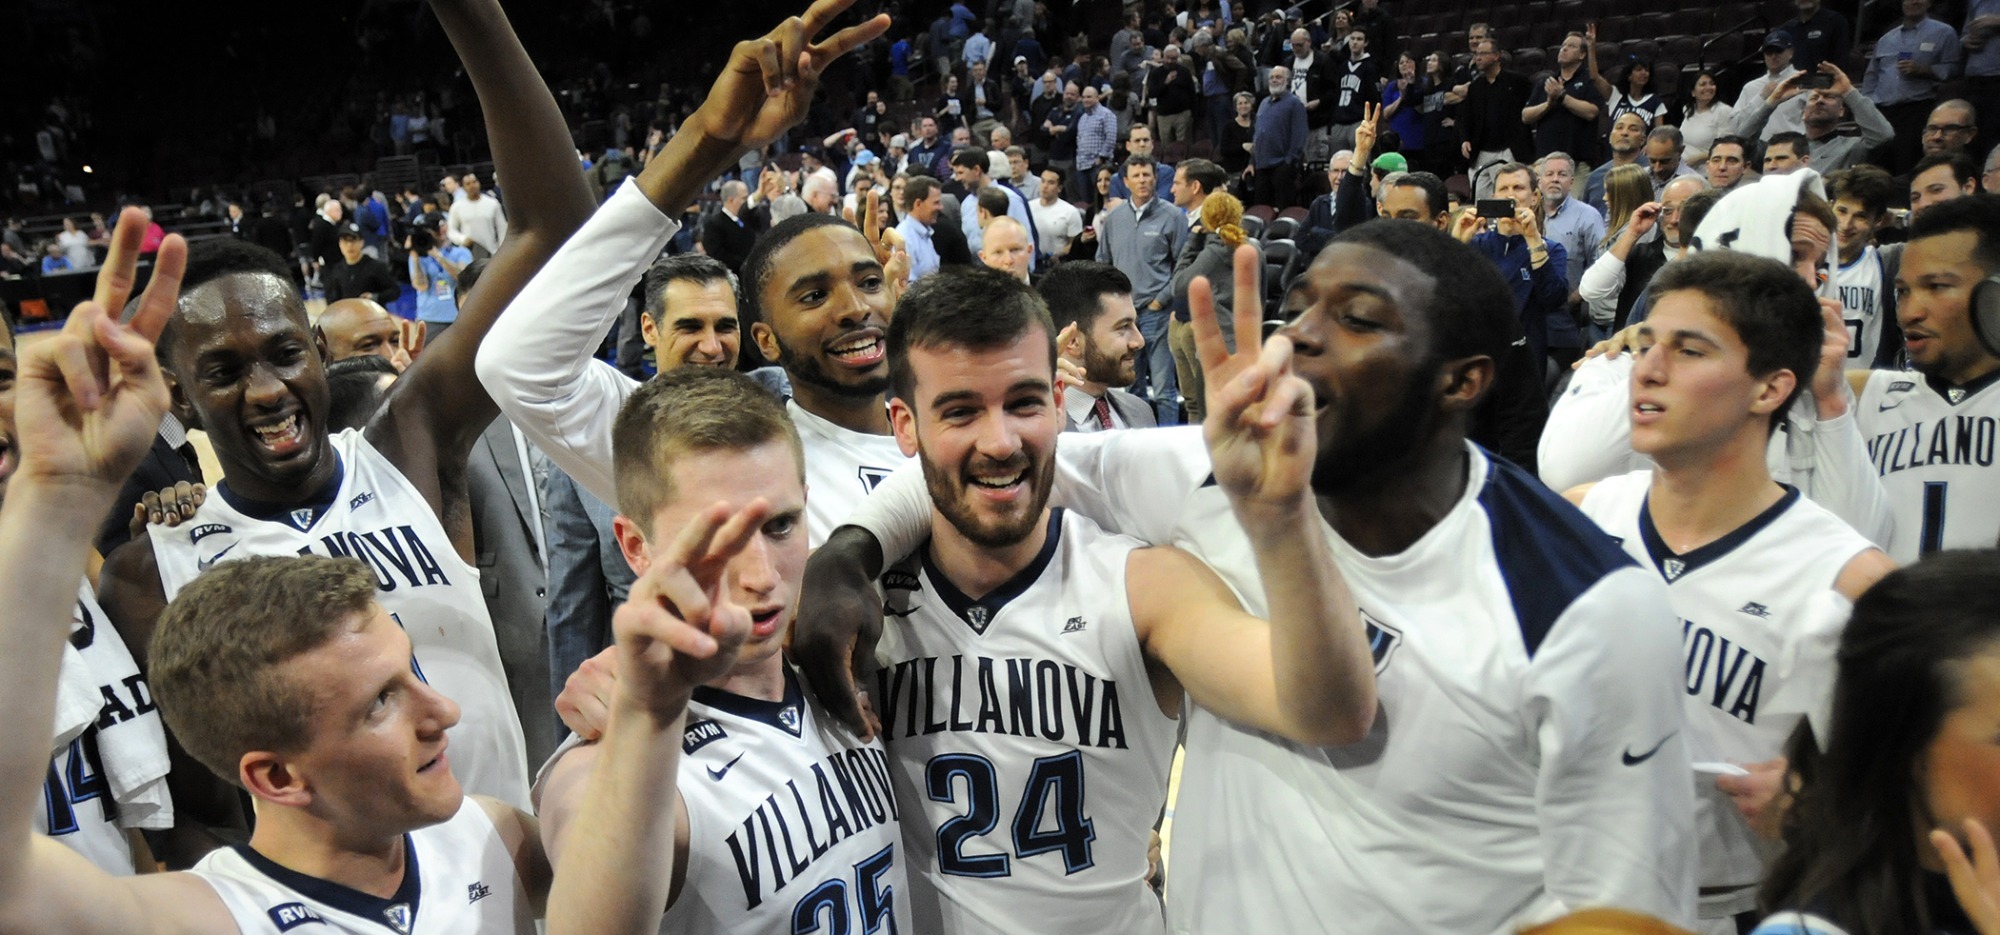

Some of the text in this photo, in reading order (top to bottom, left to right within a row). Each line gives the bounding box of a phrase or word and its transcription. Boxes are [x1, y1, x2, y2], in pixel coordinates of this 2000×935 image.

[1839, 286, 1874, 316] NOVA
[1868, 416, 2000, 477] VILLANO
[194, 524, 226, 537] RVM
[1678, 616, 1768, 725] OVA
[876, 655, 1129, 750] VILLANOVA
[684, 722, 721, 747] RVM
[925, 749, 1096, 876] 24
